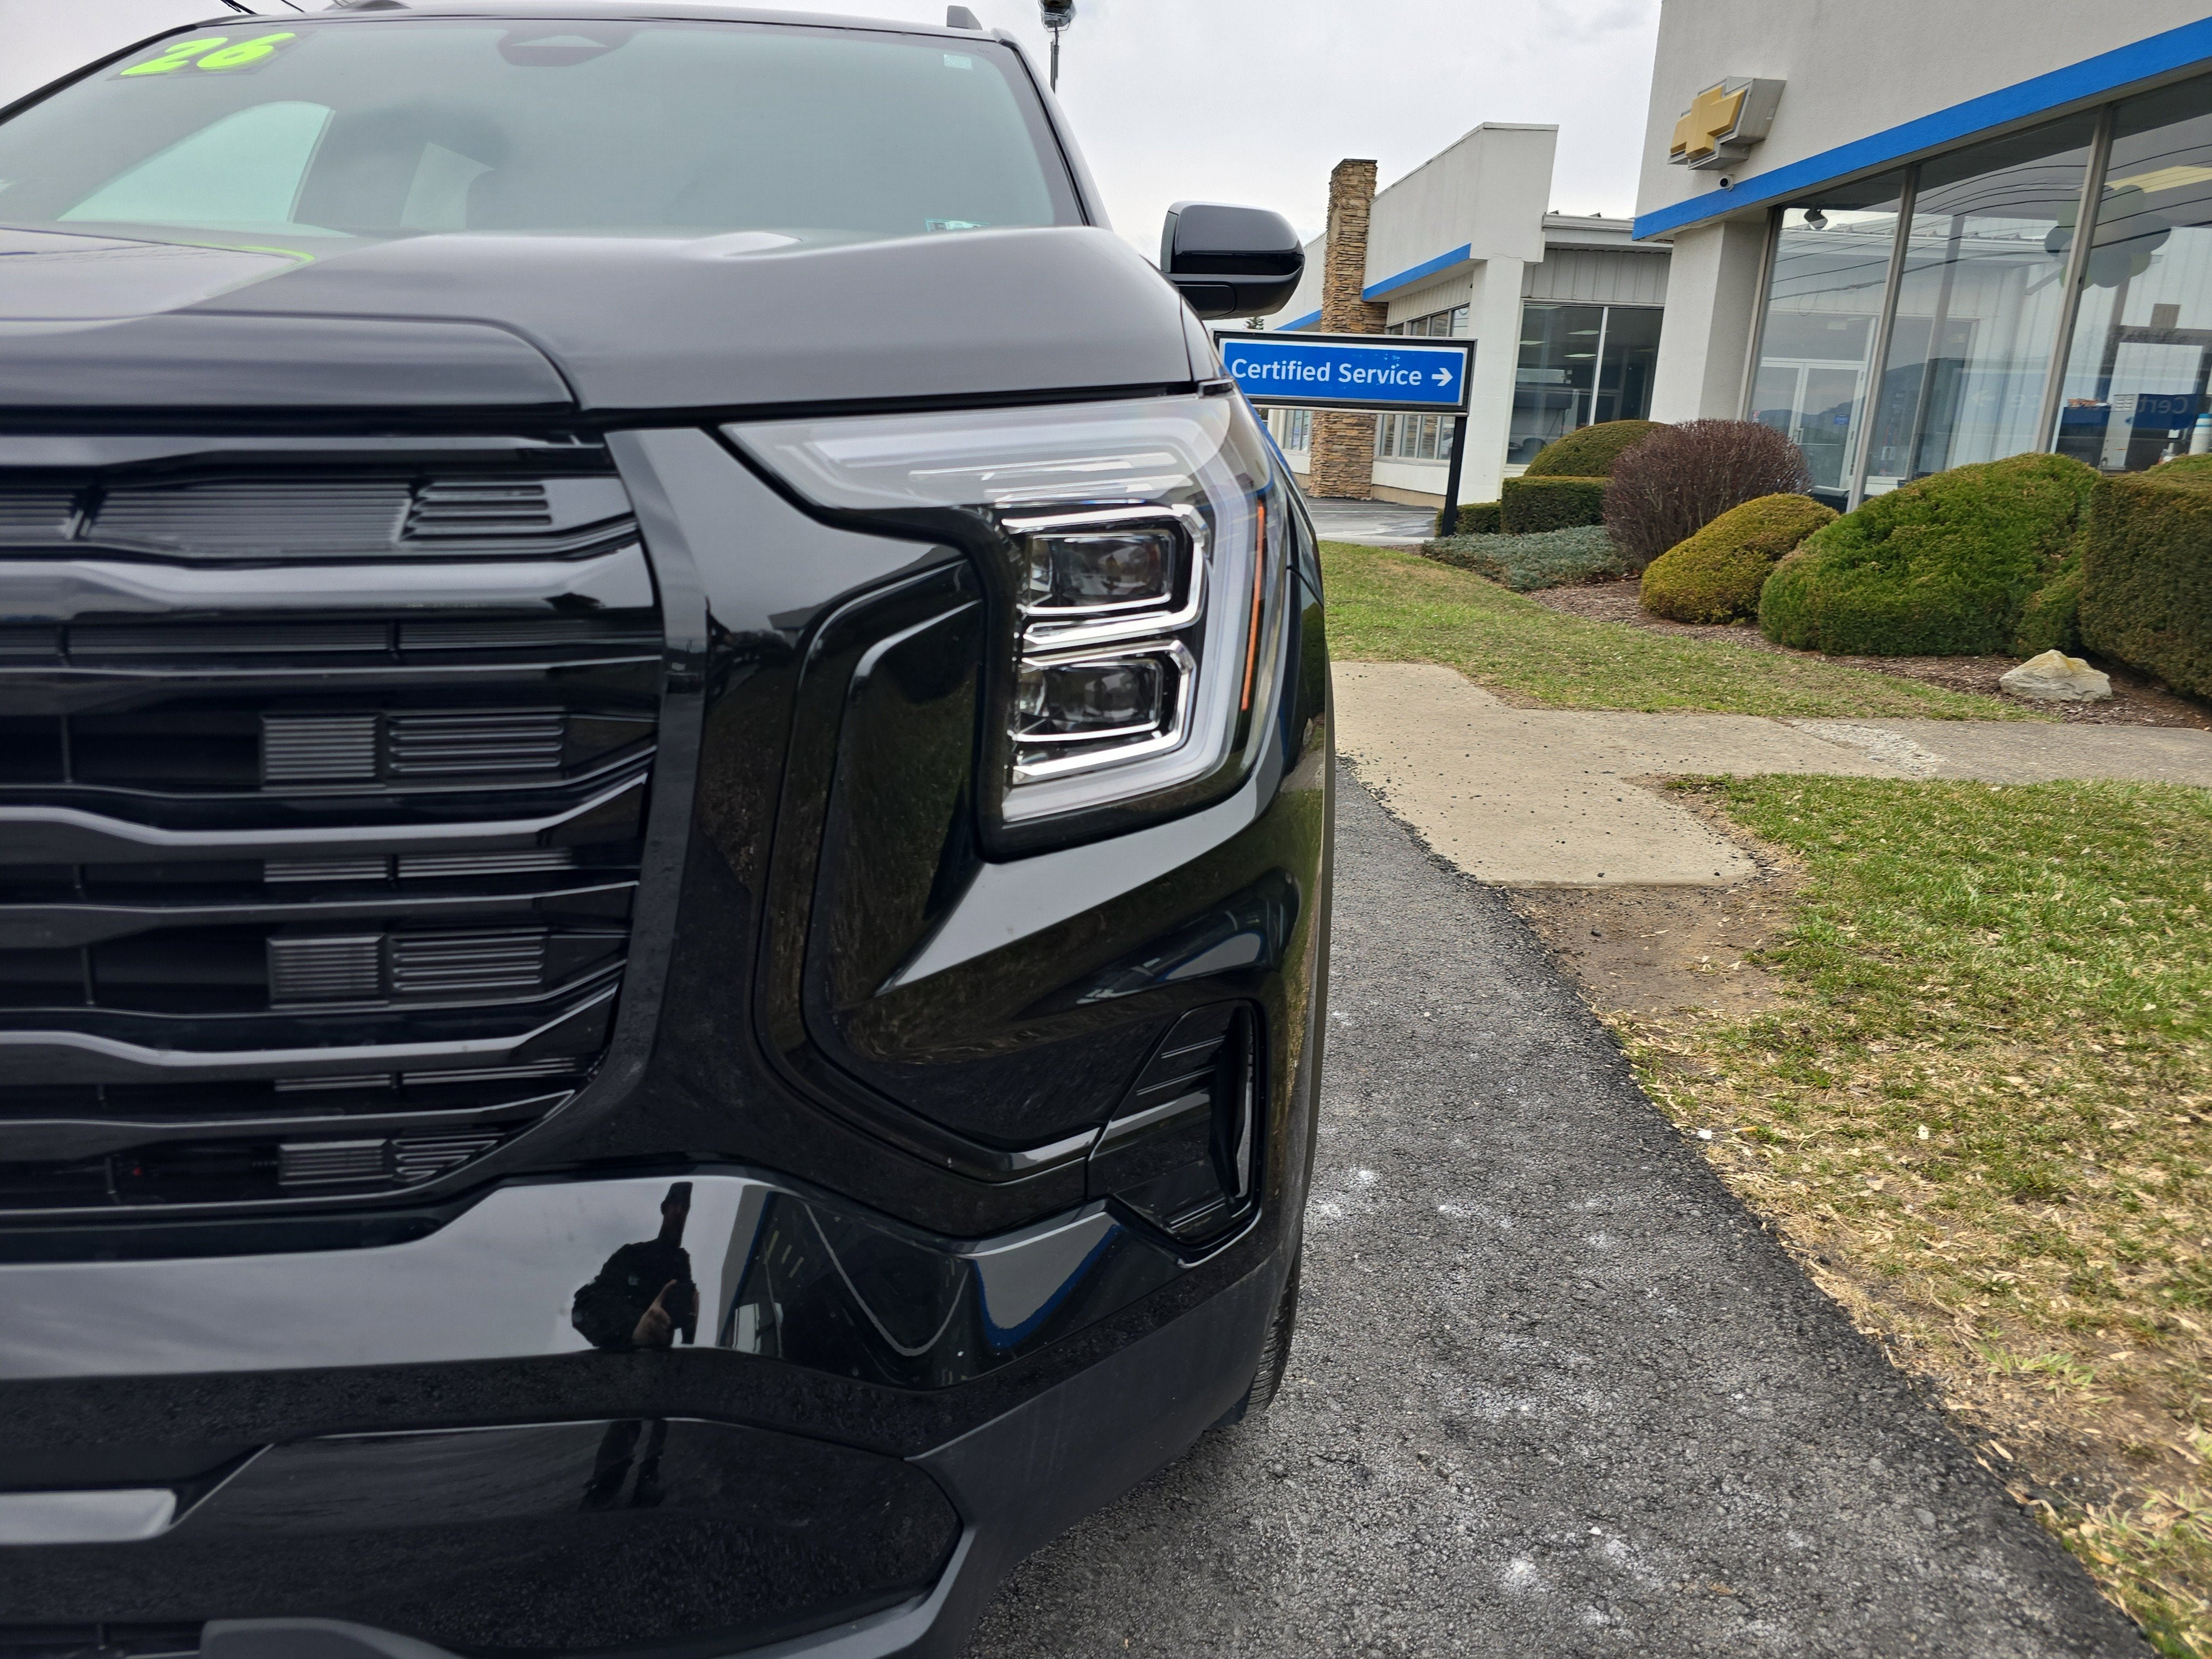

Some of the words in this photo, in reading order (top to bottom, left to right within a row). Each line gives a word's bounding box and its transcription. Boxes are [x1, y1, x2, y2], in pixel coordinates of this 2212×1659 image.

[120, 33, 296, 75] 26
[1231, 358, 1331, 382] Certified
[1338, 363, 1422, 385] Service
